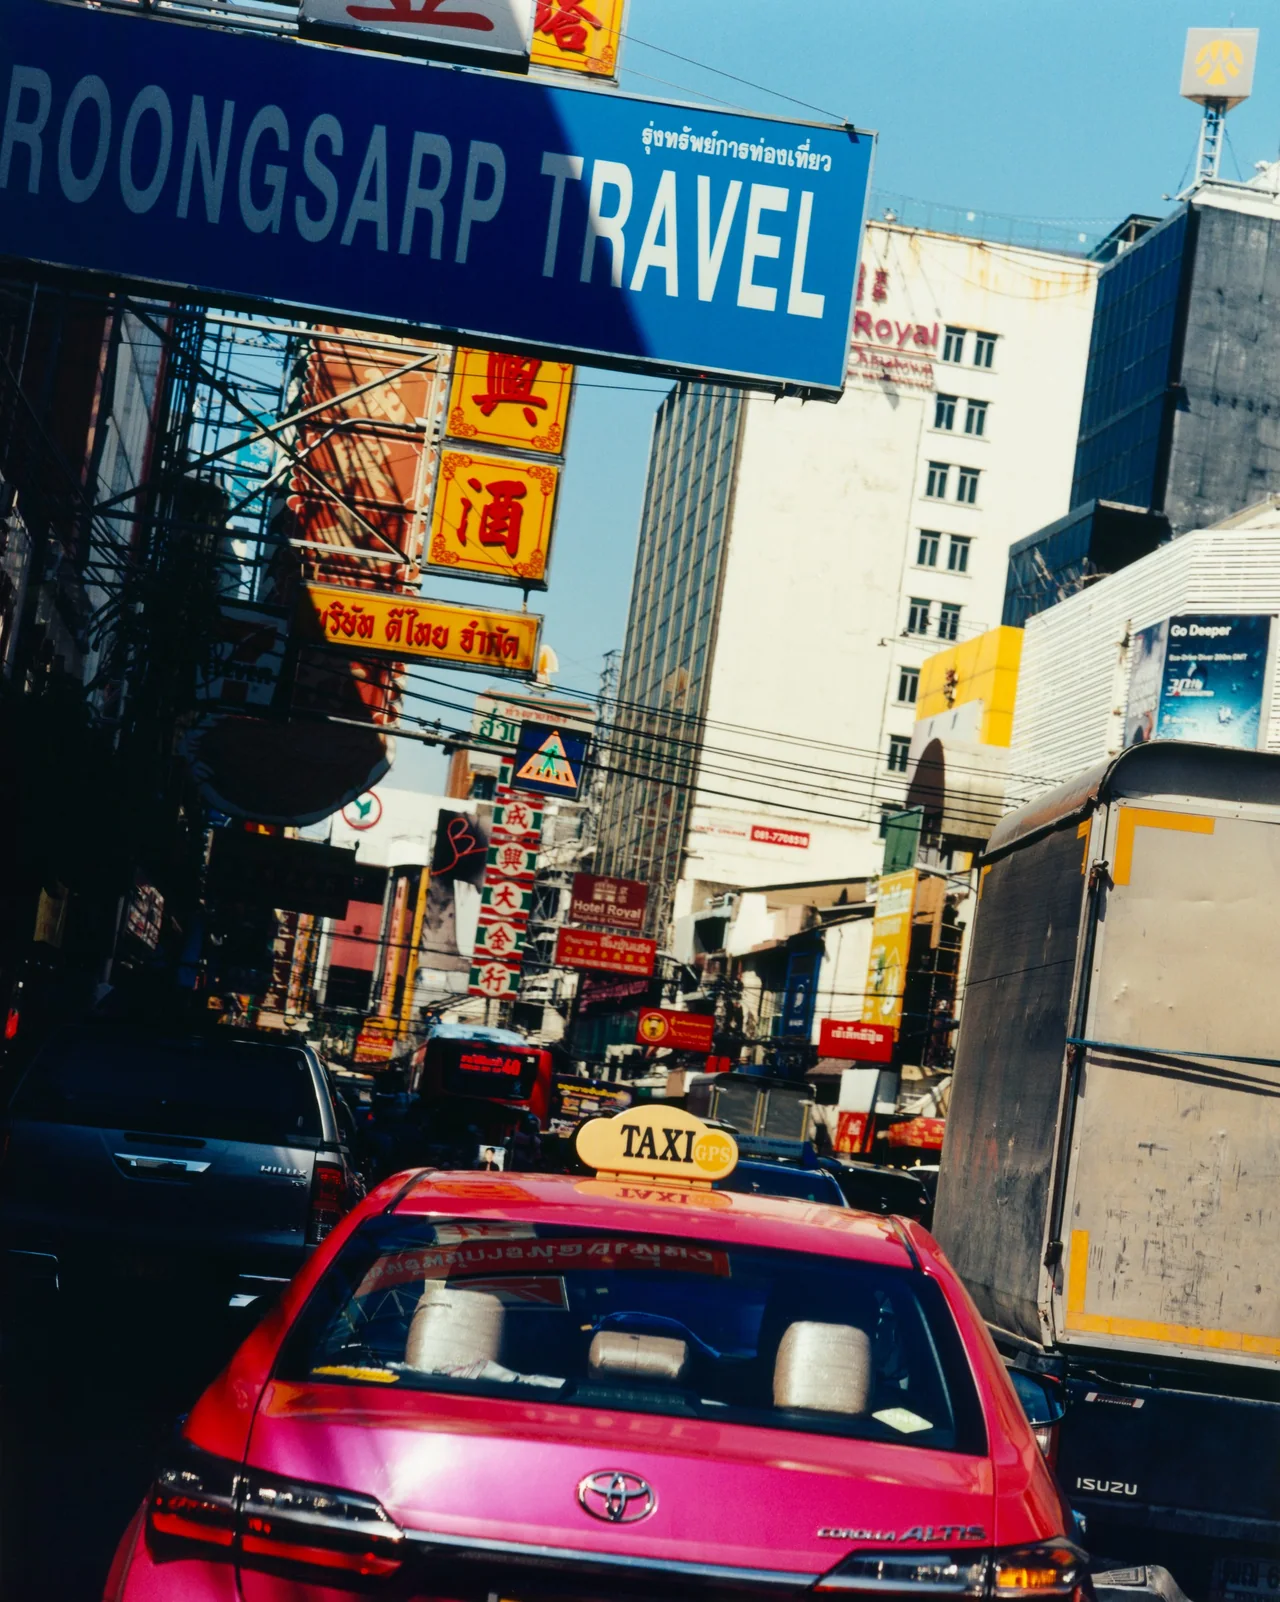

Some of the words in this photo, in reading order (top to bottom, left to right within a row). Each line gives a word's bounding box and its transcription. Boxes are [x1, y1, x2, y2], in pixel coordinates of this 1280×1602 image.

[641, 120, 832, 172] รุ่งทรัพย์การท่องเที่ยว
[0, 65, 507, 264] ROONGSARP
[541, 152, 825, 320] TRAVEL
[853, 309, 940, 347] Royal
[1170, 624, 1187, 637] Go
[1189, 624, 1231, 638] Deeper
[573, 900, 605, 915] Hotel
[607, 905, 642, 920] Royal
[620, 1124, 696, 1164] TAXI
[695, 1144, 731, 1163] GPS
[260, 1164, 308, 1179] HILUX
[1075, 1476, 1138, 1497] ISUZU
[817, 1527, 896, 1542] COROLLA
[897, 1525, 986, 1543] ALTIS
